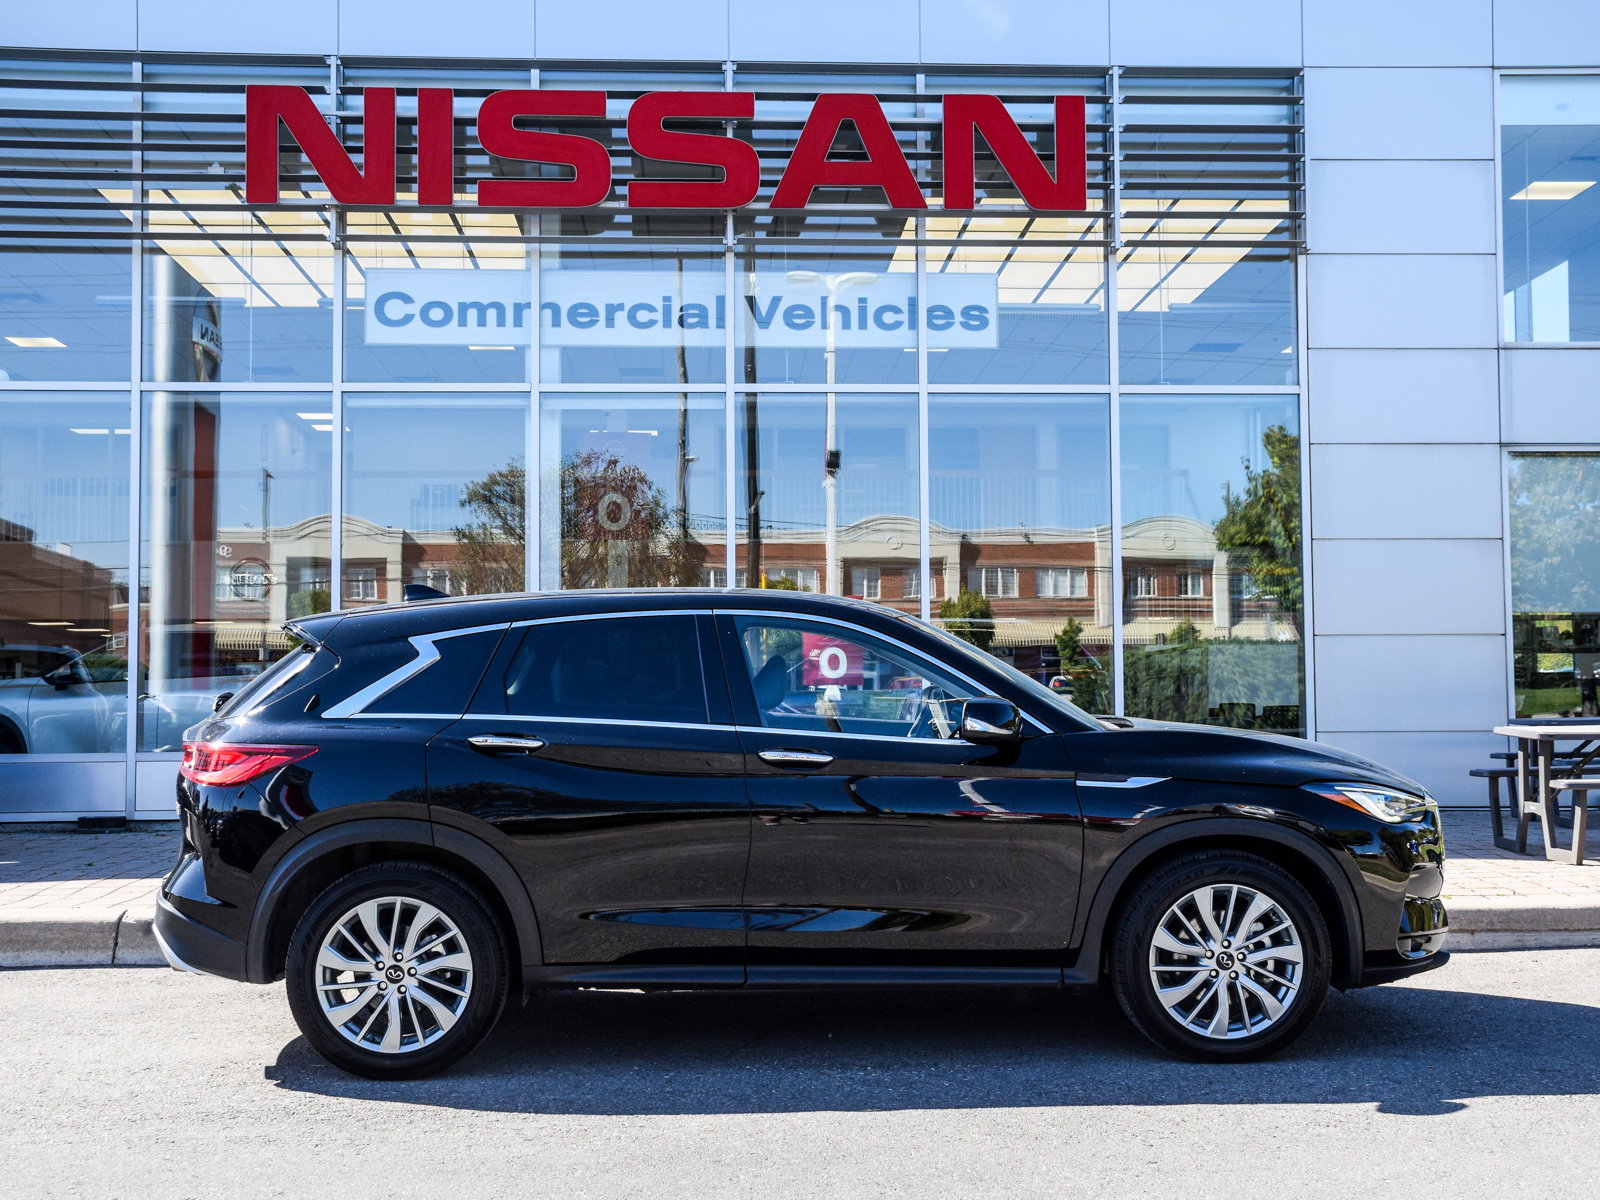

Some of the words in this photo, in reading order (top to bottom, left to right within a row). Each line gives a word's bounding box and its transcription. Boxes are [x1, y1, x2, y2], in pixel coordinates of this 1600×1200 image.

[246, 85, 1086, 210] NISSAN
[374, 291, 726, 329] Commercial
[744, 295, 989, 331] Vehicles
